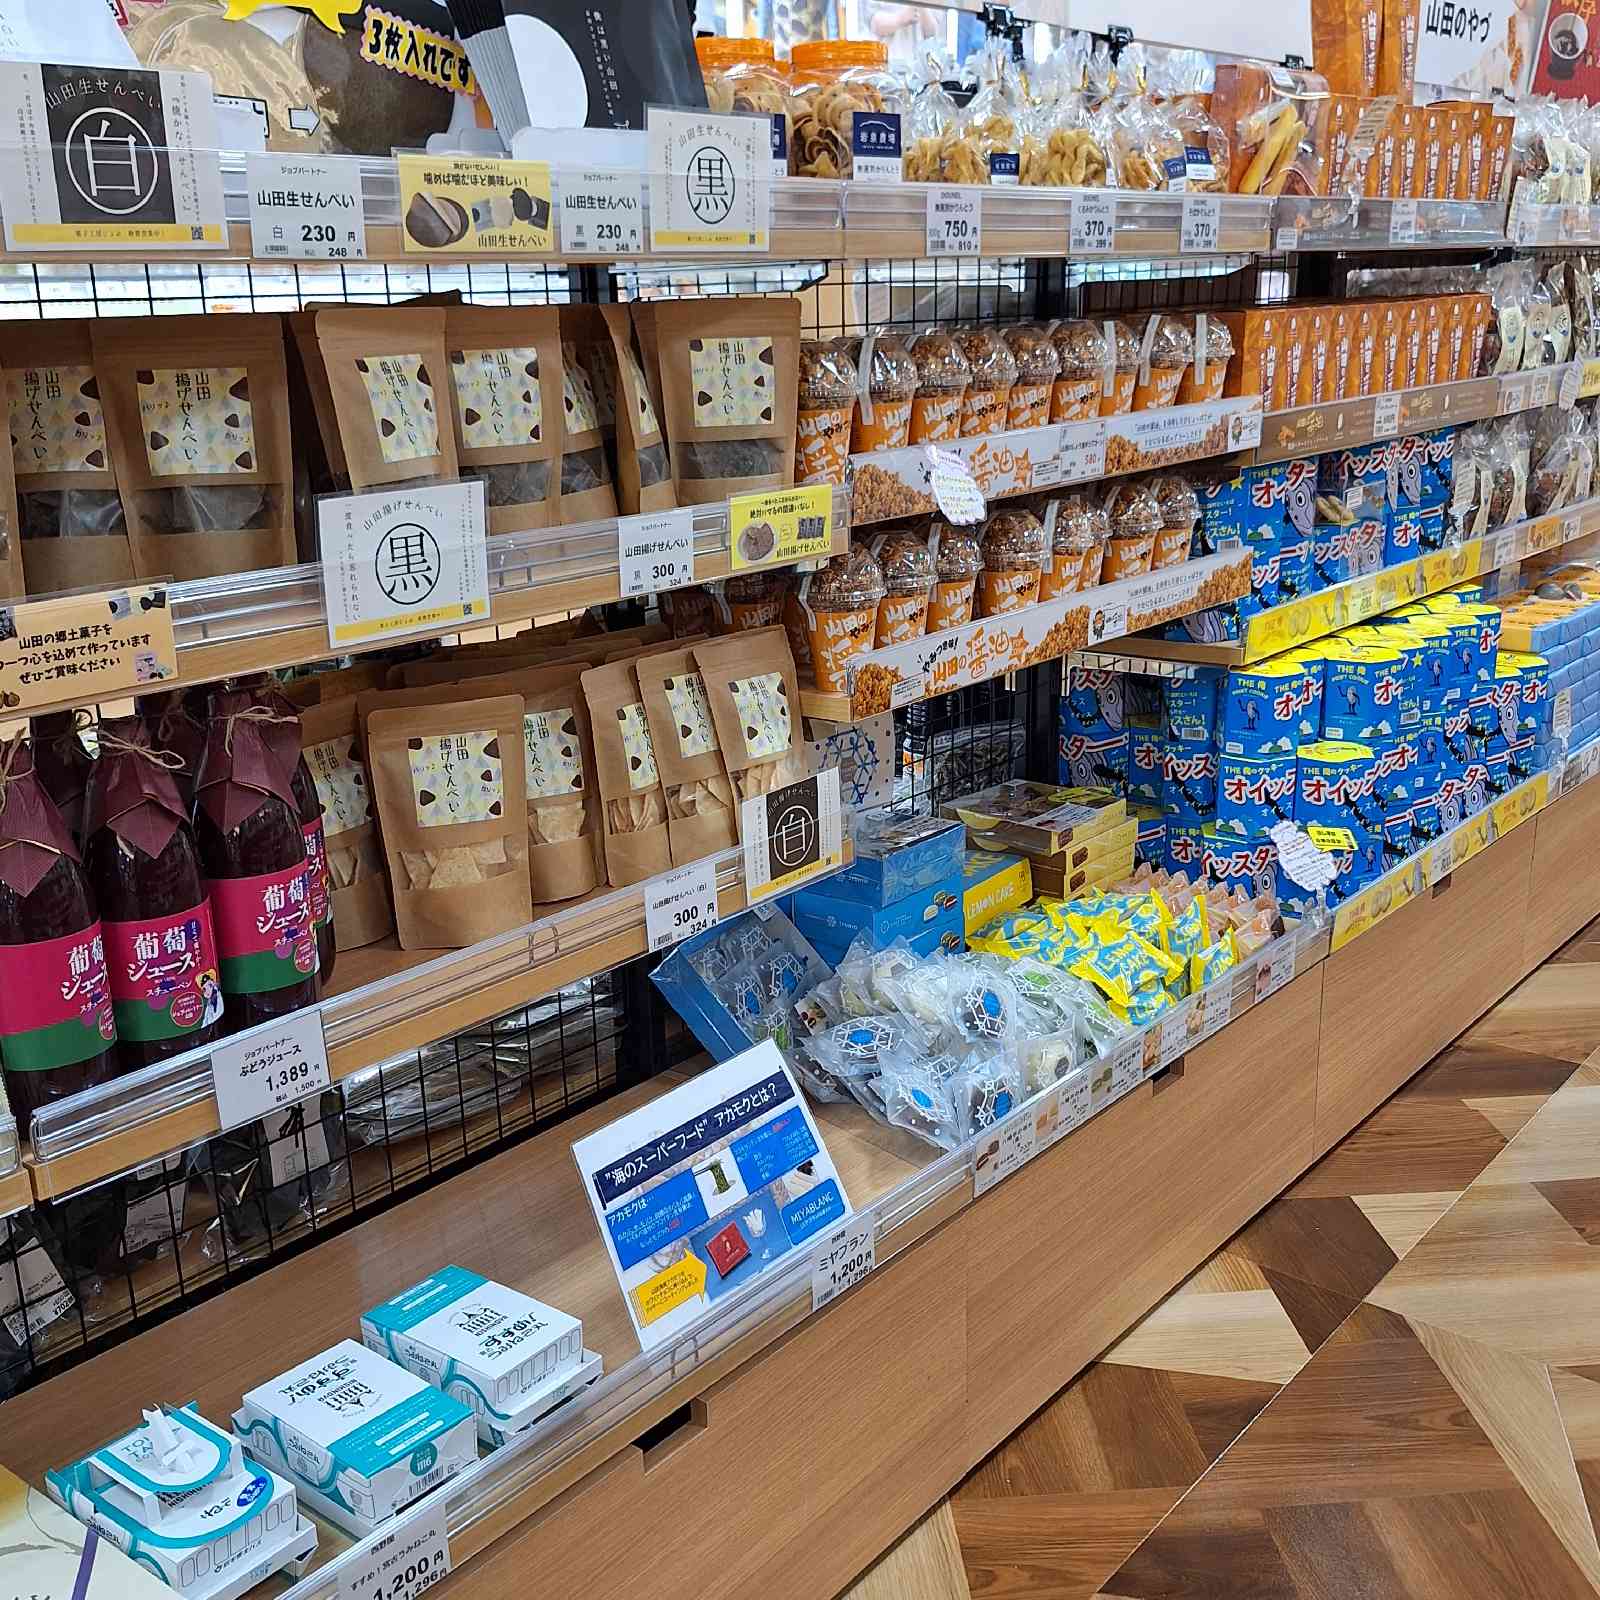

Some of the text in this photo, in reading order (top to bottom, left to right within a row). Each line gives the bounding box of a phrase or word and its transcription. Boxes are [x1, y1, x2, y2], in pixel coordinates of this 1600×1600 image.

[368, 18, 472, 88] 3枚入れです
[45, 77, 161, 110] 山田生せんべい
[83, 118, 142, 197] 白
[693, 157, 729, 211] 黒
[256, 189, 356, 209] 山田生せんべい
[565, 194, 638, 210] 山田生せんべい
[272, 224, 356, 243] 白 230 円
[477, 233, 547, 249] 山田生せんべい
[596, 223, 622, 240] 230
[630, 229, 637, 240] 円
[944, 219, 968, 238] 750
[1084, 220, 1104, 237] 370
[1194, 223, 1210, 237] 370
[327, 247, 348, 258] 248
[497, 351, 512, 379] 山田
[733, 341, 746, 365] 山田
[45, 370, 61, 400] 山田
[195, 373, 211, 400] 山田
[391, 359, 409, 387] 山田
[624, 537, 690, 558] 山田揚げせんべい
[776, 540, 831, 560] 山田揚げせんべい
[385, 531, 433, 596] 黒
[652, 562, 675, 579] 300
[18, 622, 113, 650] 山田の郷土菓子を
[18, 656, 121, 685] ぜひご賞味ください
[455, 736, 470, 762] 山田
[1224, 765, 1241, 775] THE
[1303, 767, 1321, 776] THE
[781, 813, 806, 860] 白
[255, 876, 304, 913] 葡萄
[256, 901, 310, 934] ジュース
[673, 902, 715, 927] 300 円
[690, 919, 707, 936] 324
[130, 925, 187, 961] 葡萄
[127, 951, 196, 982] ジュース
[239, 1044, 302, 1077] ぶどうジュース
[713, 1082, 778, 1128] アカモクとは？
[789, 1192, 835, 1226] MIYABLANC
[818, 1232, 869, 1272] ミヤブラン
[830, 1253, 864, 1285] 1,200
[372, 1549, 444, 1600] 1,200 円
[402, 1570, 439, 1600] 1,296
